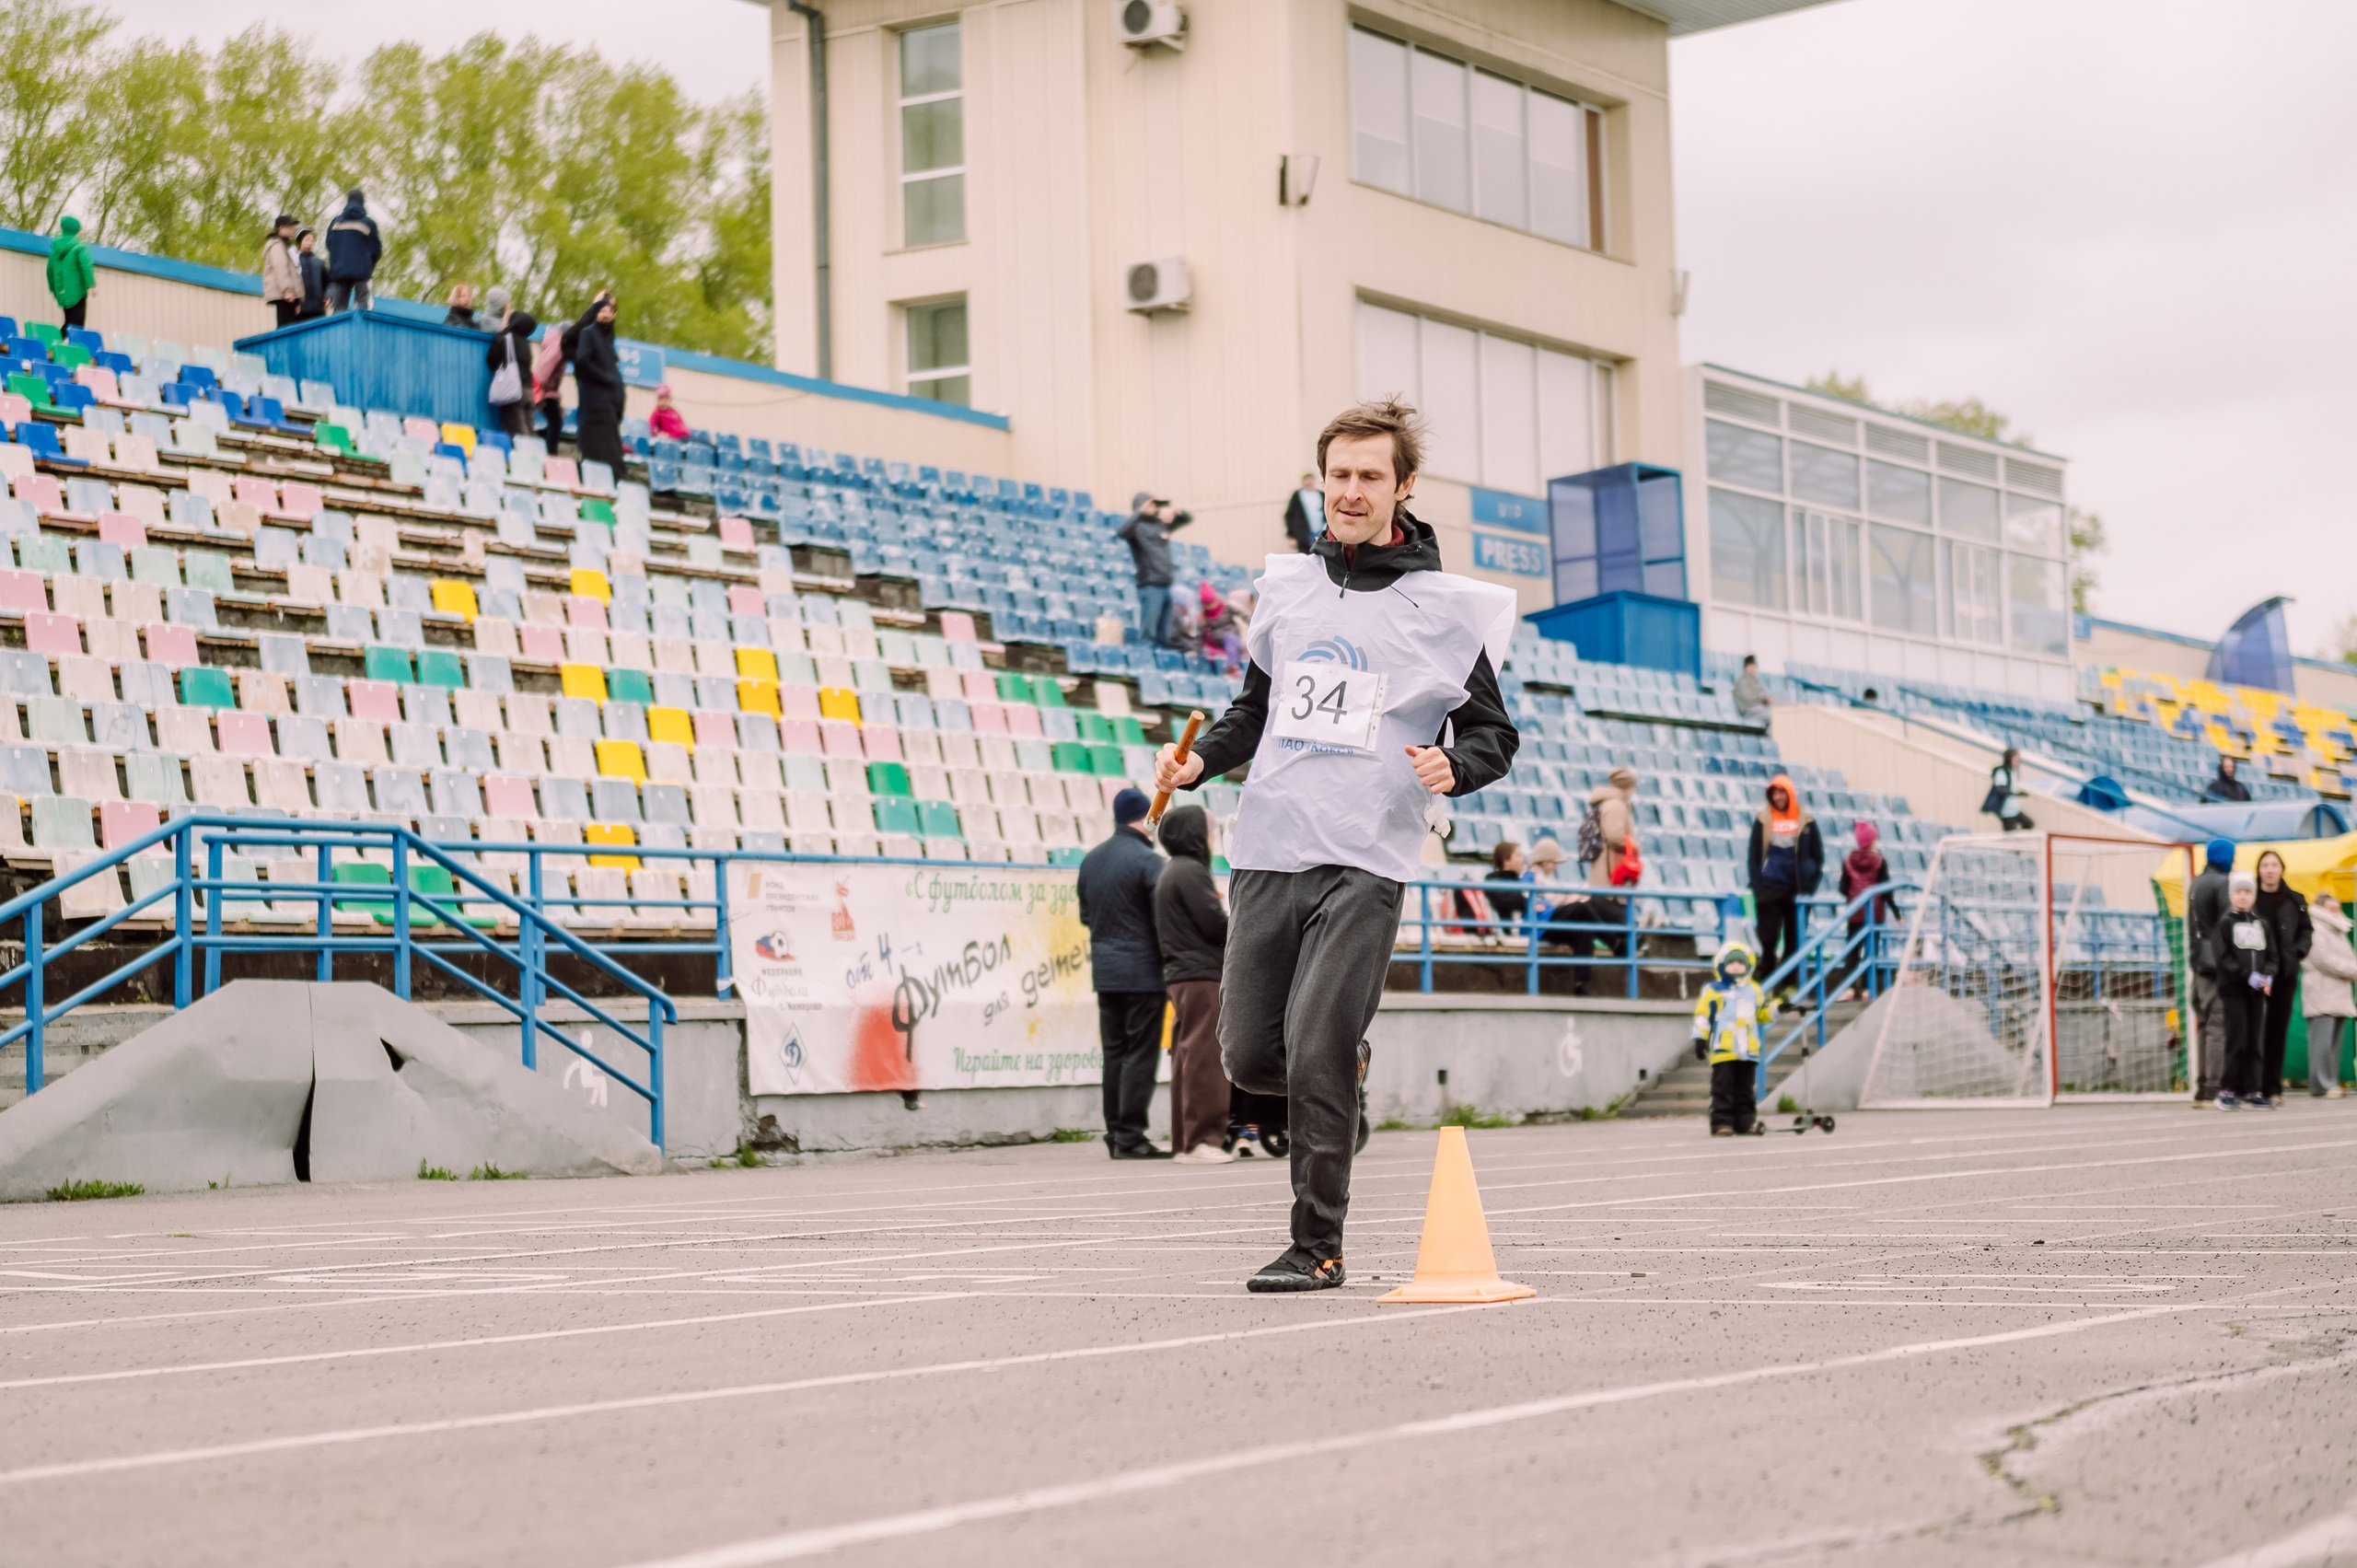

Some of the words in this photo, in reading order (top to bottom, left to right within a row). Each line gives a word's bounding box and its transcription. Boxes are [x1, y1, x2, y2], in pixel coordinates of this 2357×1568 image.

[1481, 539, 1541, 574] PRESS
[1291, 675, 1348, 725] 34
[928, 872, 1023, 914] футболом
[1027, 883, 1046, 915] за
[983, 991, 1010, 1028] для
[954, 1047, 1022, 1084] Играйте
[1026, 1053, 1044, 1071] на
